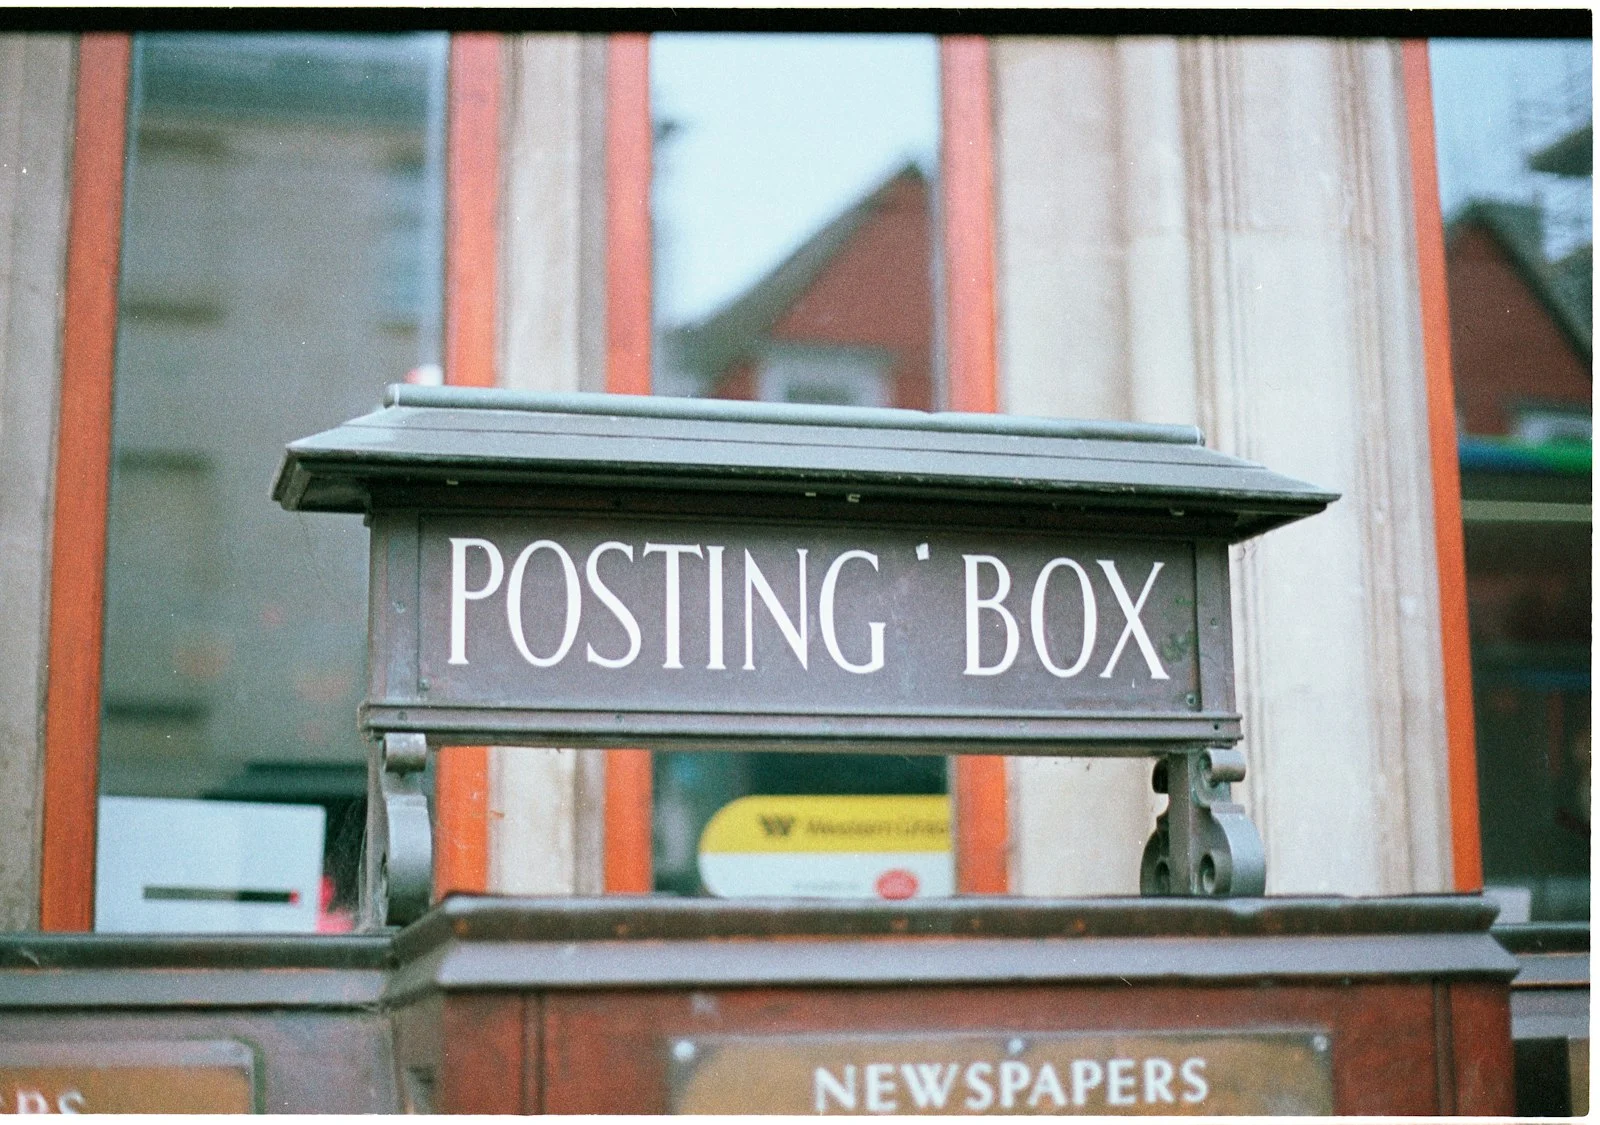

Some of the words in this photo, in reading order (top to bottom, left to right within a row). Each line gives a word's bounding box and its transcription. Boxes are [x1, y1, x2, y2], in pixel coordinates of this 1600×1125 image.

[447, 537, 887, 675] POSTING
[962, 554, 1171, 680] BOX
[813, 1057, 1210, 1111] NEWSPAPERS
